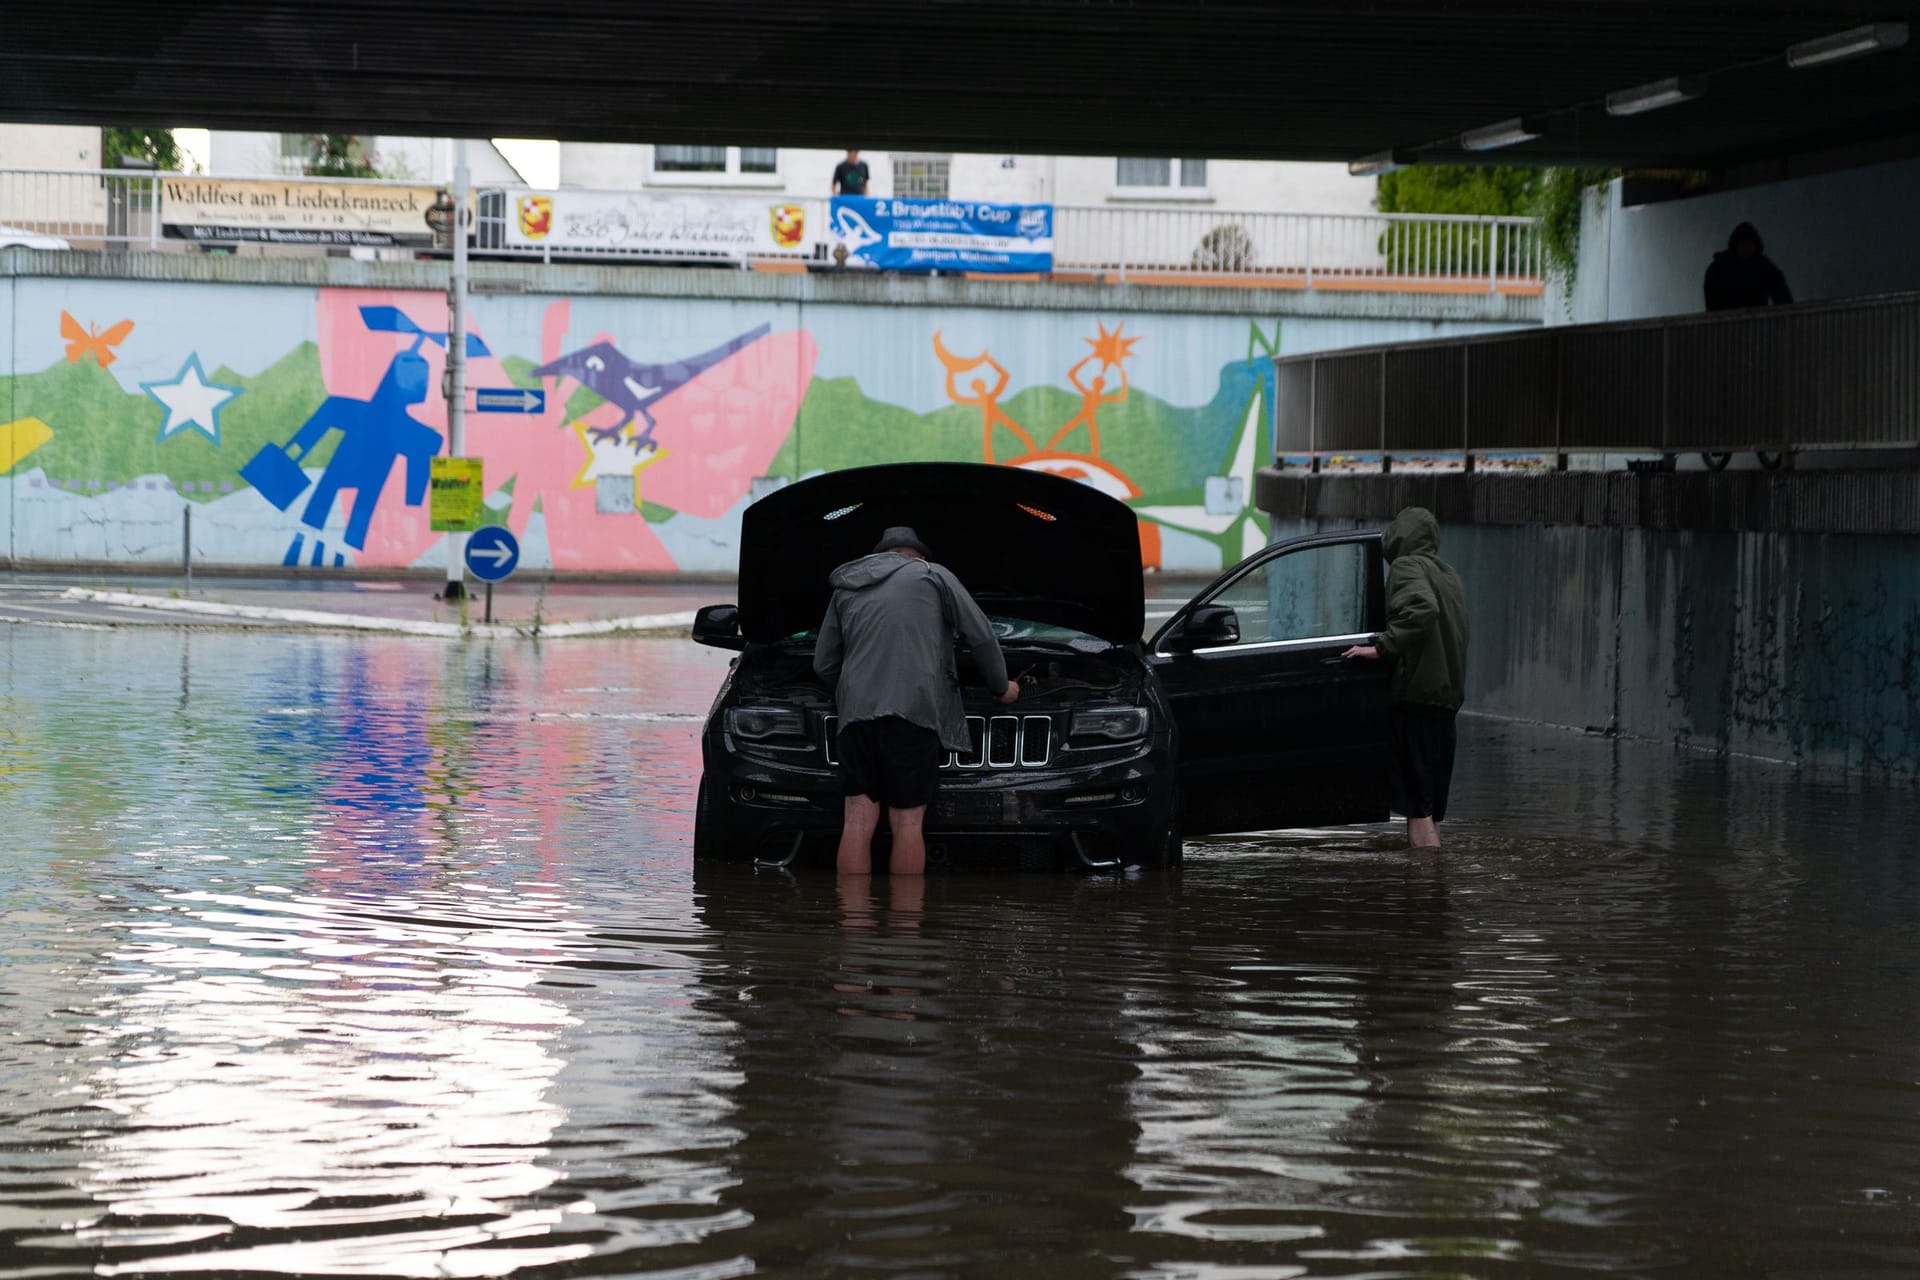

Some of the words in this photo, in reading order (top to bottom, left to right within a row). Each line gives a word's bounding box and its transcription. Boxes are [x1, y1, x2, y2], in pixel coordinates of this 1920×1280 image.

[167, 183, 243, 206] Waldfest
[250, 193, 277, 207] am
[284, 187, 419, 212] Liederkranzeck
[875, 200, 890, 217] 2.
[977, 204, 1012, 224] Cup
